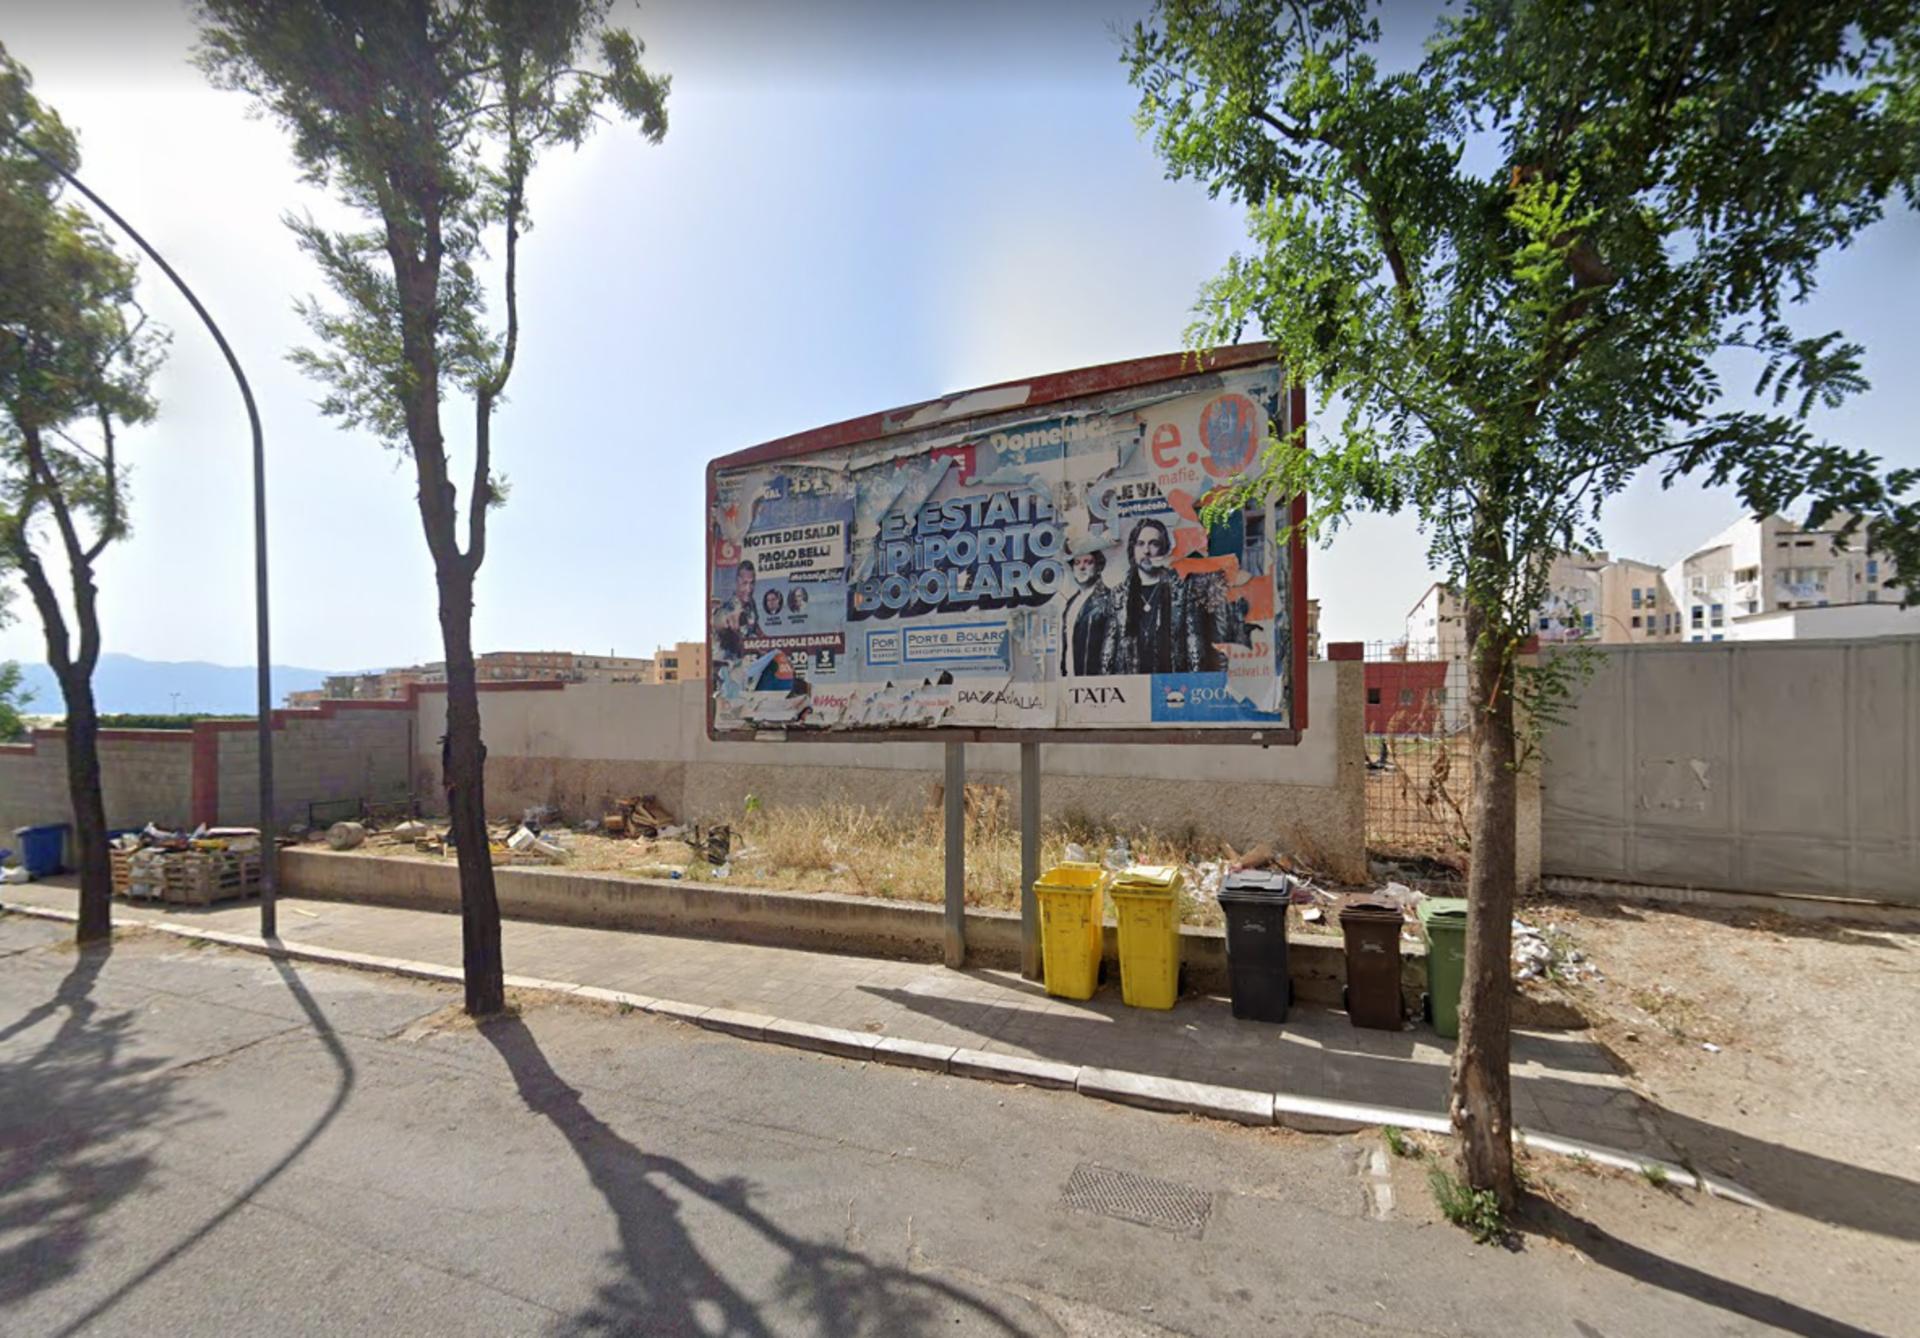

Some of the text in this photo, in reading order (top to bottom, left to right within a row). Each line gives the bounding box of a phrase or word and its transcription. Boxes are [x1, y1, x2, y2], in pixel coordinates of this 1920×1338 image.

[744, 523, 841, 548] NOTTE DEI SALDI
[758, 544, 832, 564] PAOLO BELLI
[771, 637, 807, 648] SCUOLE
[807, 635, 841, 646] DANZA
[1068, 686, 1126, 704] TATA
